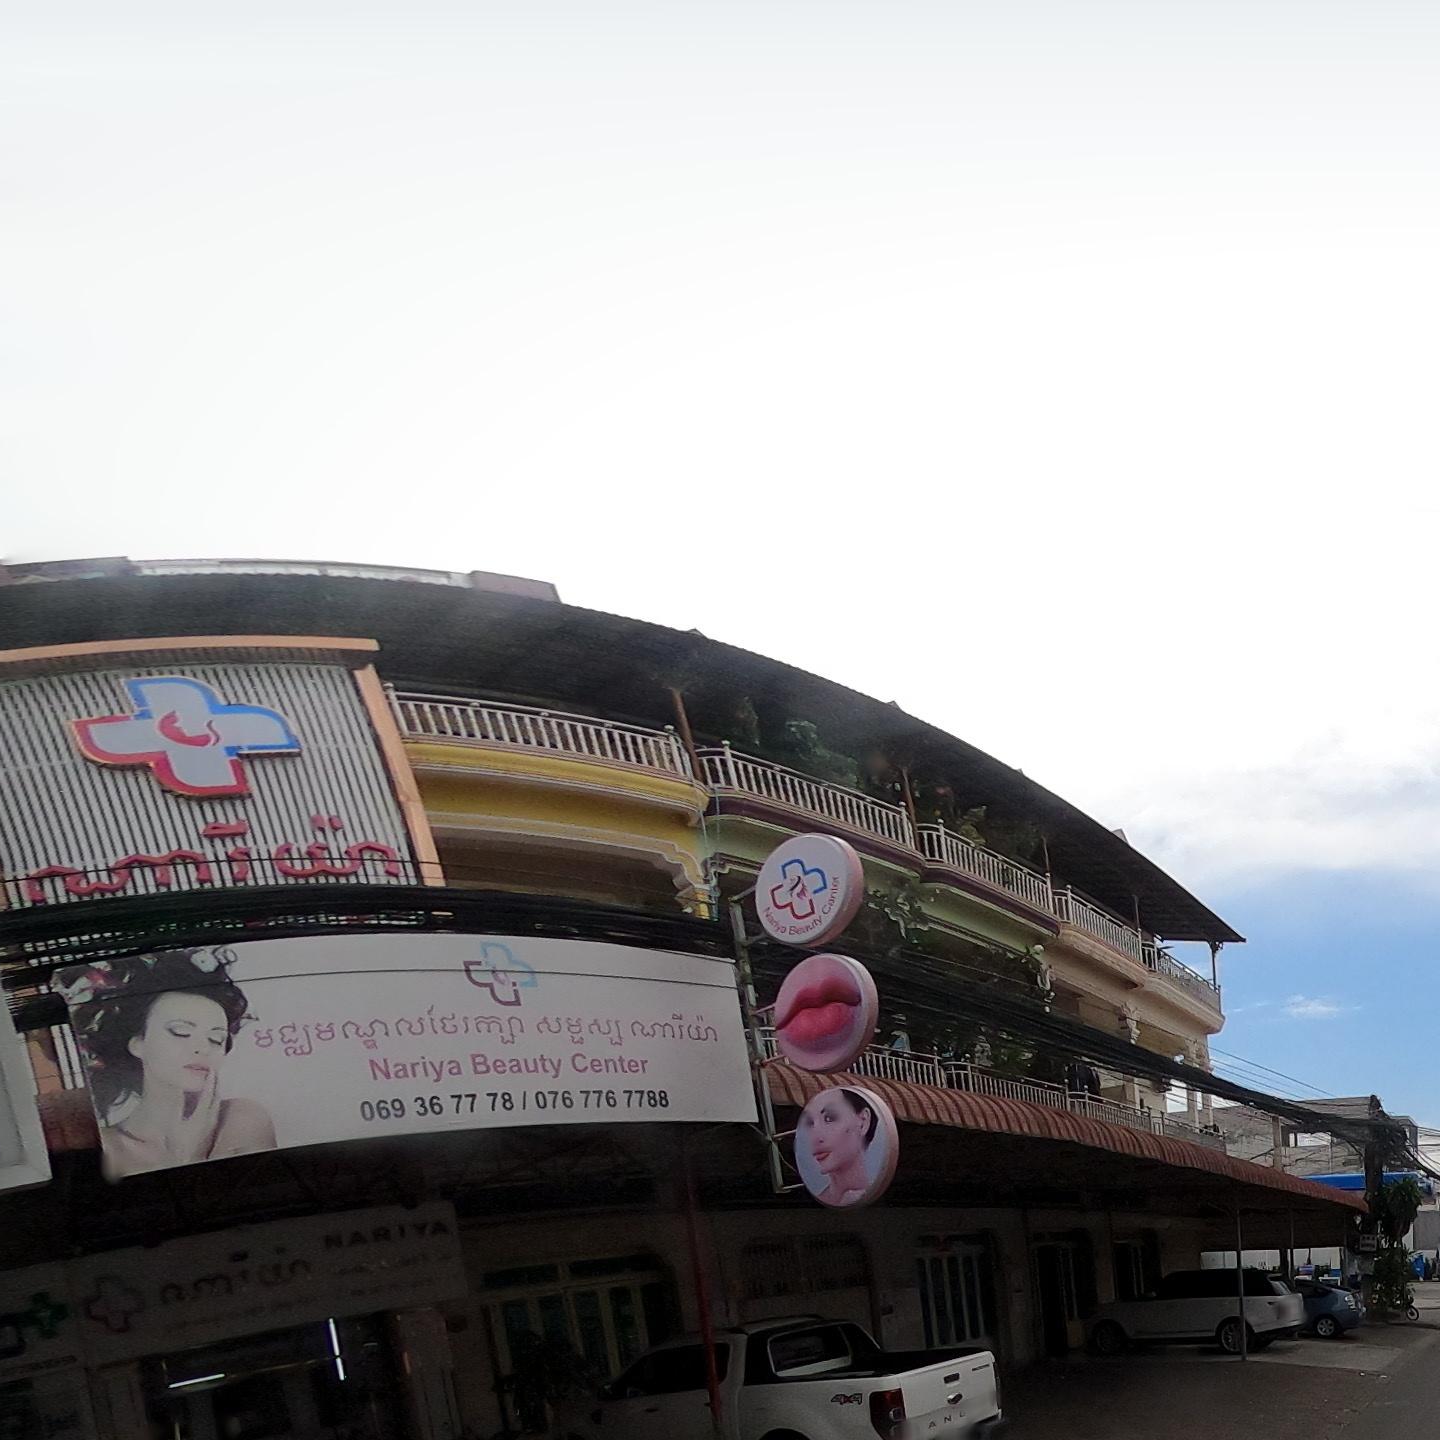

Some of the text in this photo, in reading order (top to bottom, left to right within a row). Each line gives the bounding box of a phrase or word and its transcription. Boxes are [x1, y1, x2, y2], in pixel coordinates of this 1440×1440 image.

[788, 916, 822, 935] Beauty
[369, 1053, 648, 1083] Nariya Beauty Center
[360, 1098, 406, 1121] 069
[414, 1095, 444, 1116] 36
[450, 1093, 477, 1114] 77
[487, 1092, 514, 1112] 78
[535, 1090, 575, 1109] 076
[579, 1090, 617, 1109] 776
[623, 1089, 669, 1108] 7788
[324, 1221, 449, 1249] NARIYA
